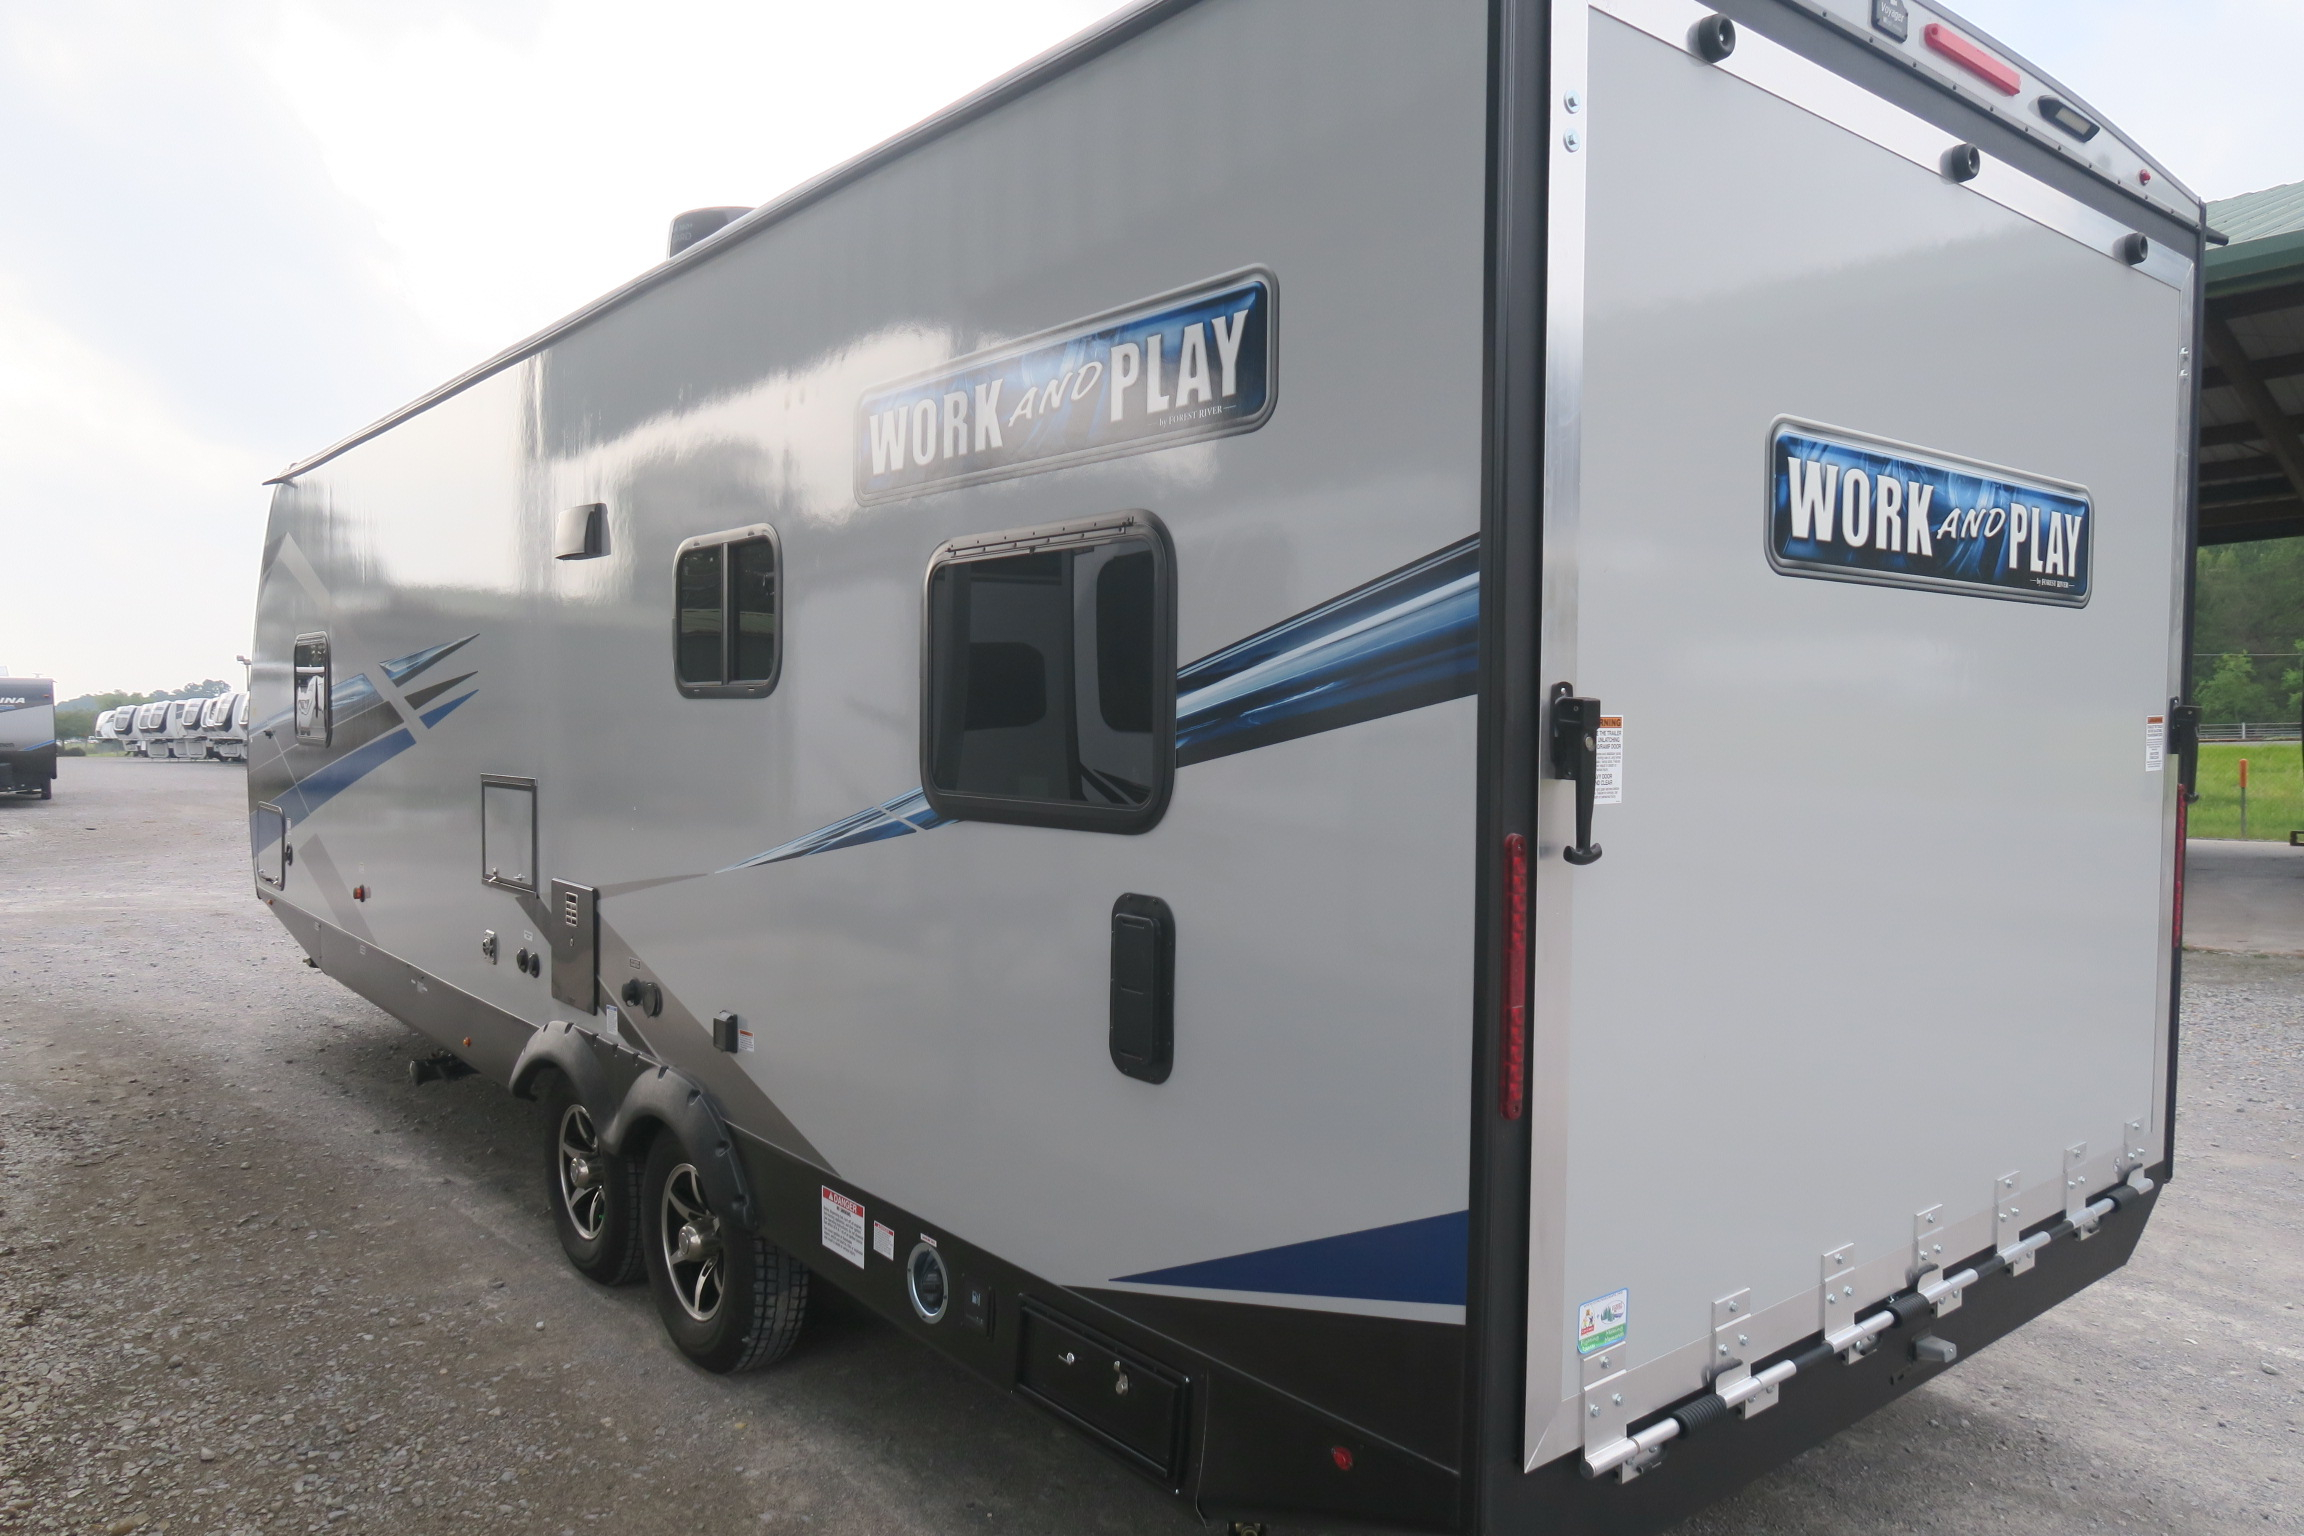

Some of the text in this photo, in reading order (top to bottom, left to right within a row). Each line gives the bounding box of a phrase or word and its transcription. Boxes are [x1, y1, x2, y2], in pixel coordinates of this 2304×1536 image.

[1881, 2, 1904, 22] Voyager
[868, 309, 1250, 476] WORK AND PLAY
[1159, 405, 1223, 428] by FOREST RIVER
[1787, 456, 2083, 578] WORK AND PLAY
[1600, 718, 1621, 727] RNING
[833, 1194, 858, 1214] DANGER
